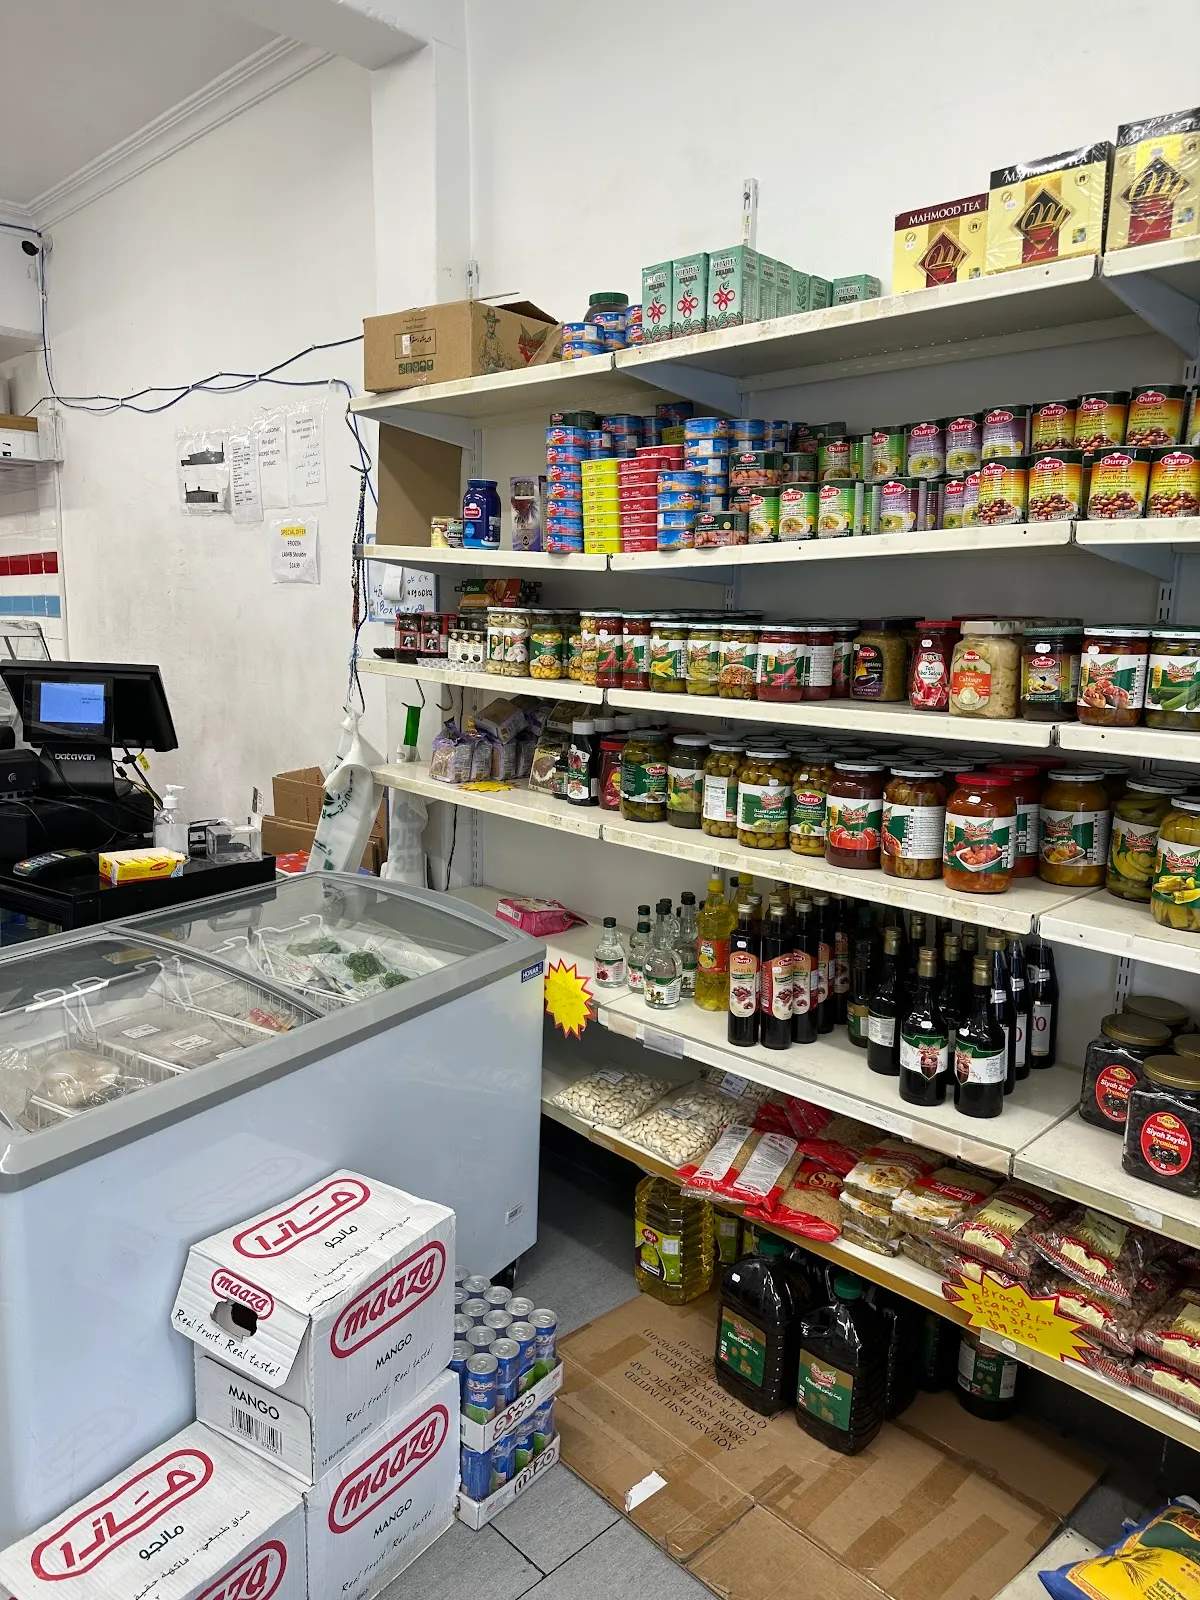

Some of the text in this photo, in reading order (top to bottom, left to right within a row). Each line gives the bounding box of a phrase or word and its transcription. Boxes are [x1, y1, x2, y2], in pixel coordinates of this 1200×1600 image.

[909, 202, 980, 225] MAHMOOD TEA
[1083, 402, 1106, 410] Durra
[1139, 395, 1163, 403] Durra
[987, 412, 1010, 422] Durra
[1042, 407, 1064, 416] Durra
[914, 426, 936, 437] Durra
[951, 422, 973, 431] Durra
[1038, 461, 1061, 470] Durra
[1104, 457, 1130, 466] Durra
[1164, 456, 1191, 465] Durra
[984, 466, 1004, 475] Durra
[968, 475, 980, 485] Dur
[783, 491, 803, 500] Durra
[884, 485, 904, 493] Durra
[947, 485, 964, 494] Durra
[799, 795, 819, 803] Durra
[1100, 1079, 1130, 1094] Siyah Zey
[1146, 1127, 1166, 1139] Siyah
[1166, 1132, 1188, 1147] Zeytin
[1152, 1136, 1180, 1151] Premium
[324, 1225, 358, 1249] مانجو
[216, 1276, 269, 1312] maaza
[343, 1253, 437, 1342] maaza
[982, 1286, 1027, 1310] Broad
[972, 1294, 1020, 1317] Beans
[175, 1309, 197, 1327] Real
[225, 1338, 249, 1360] Real
[250, 1353, 281, 1377] taste!
[375, 1333, 412, 1370] MANGO
[630, 1361, 651, 1376] CAP
[652, 1348, 712, 1390] PCS/CARTON
[345, 1402, 366, 1427] Real
[393, 1364, 411, 1388] Real
[649, 1376, 692, 1405] PLASTIC
[670, 1375, 717, 1408] NATURAL
[228, 1384, 280, 1420] MANGO
[623, 1370, 736, 1450] AQUASPLASH LIMITED
[692, 1406, 714, 1420] 1881
[713, 1421, 747, 1445] 28MM
[343, 1416, 438, 1518] maaza
[374, 1498, 412, 1539] MANGO
[138, 1525, 185, 1560] مانجو
